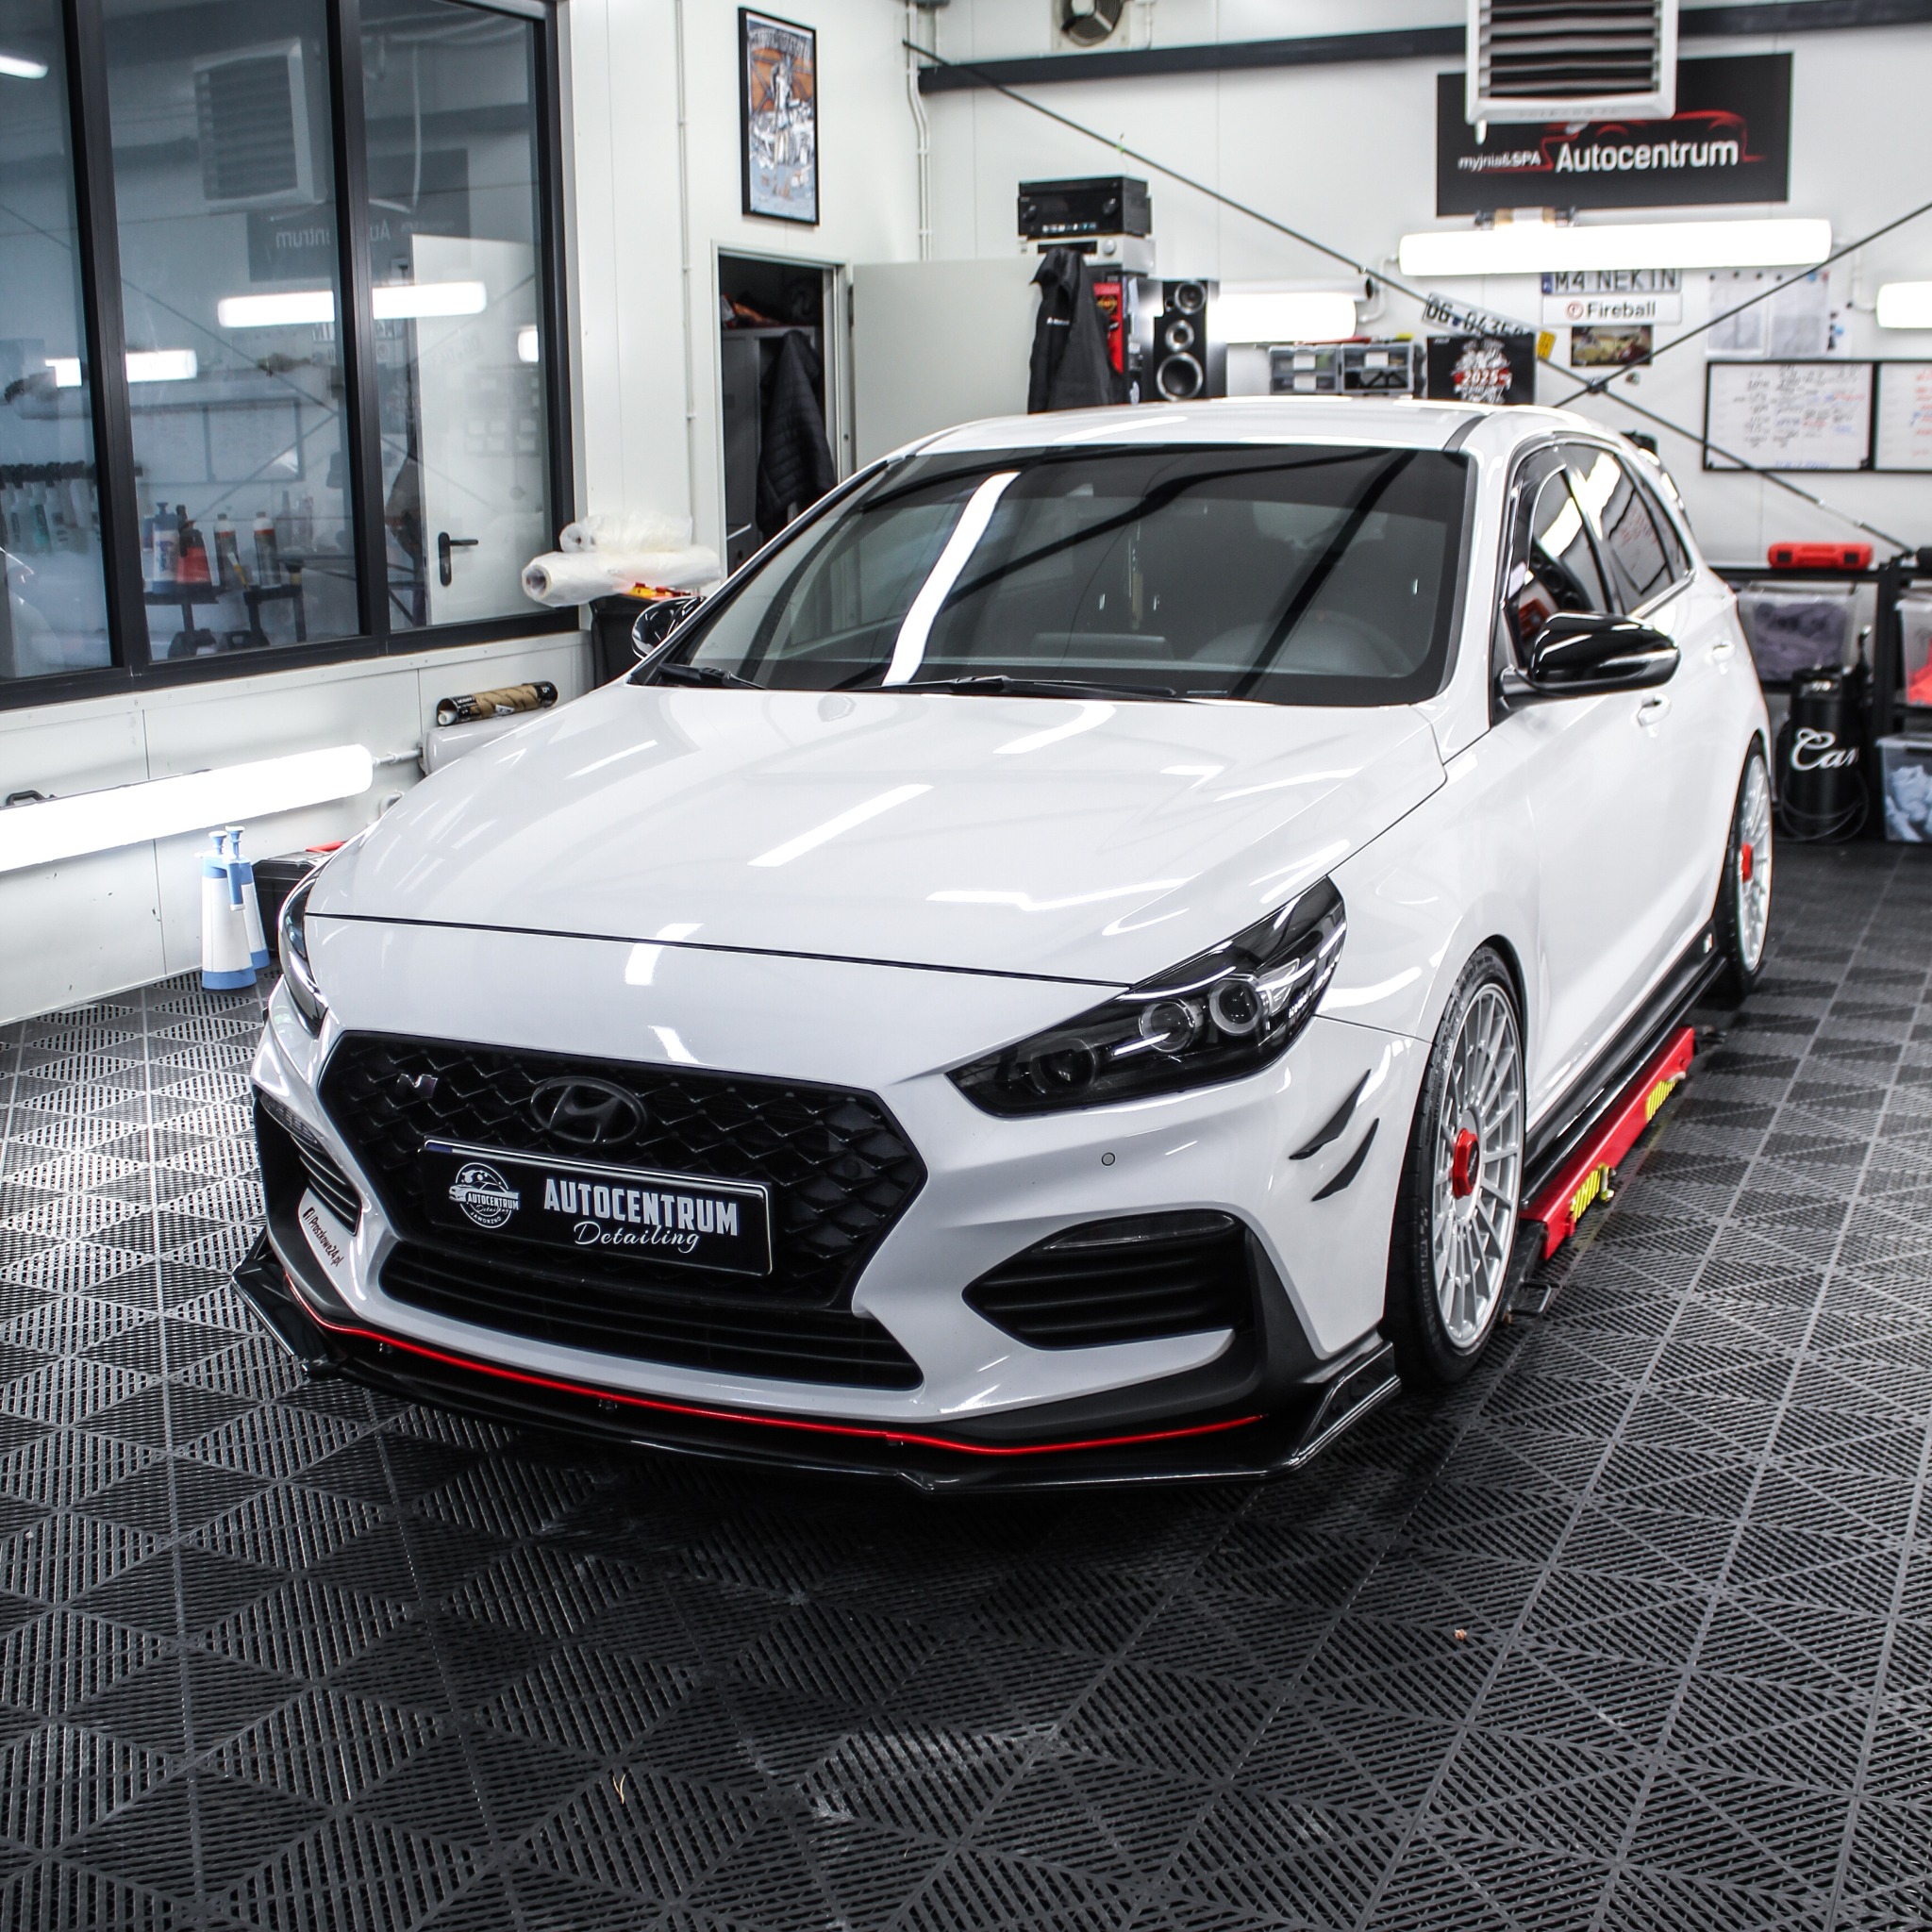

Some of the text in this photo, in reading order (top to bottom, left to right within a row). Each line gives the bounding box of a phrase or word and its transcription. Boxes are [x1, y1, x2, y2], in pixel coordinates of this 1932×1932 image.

[1556, 140, 1740, 174] Autocentrum
[1555, 271, 1585, 291] M4
[1587, 301, 1657, 319] Fireball
[467, 1192, 519, 1210] AUTOCENTRUM
[543, 1178, 739, 1237] AUTOCENTRUM
[308, 1216, 344, 1267] Proszkowe24.pl
[574, 1221, 700, 1254] Detailing
